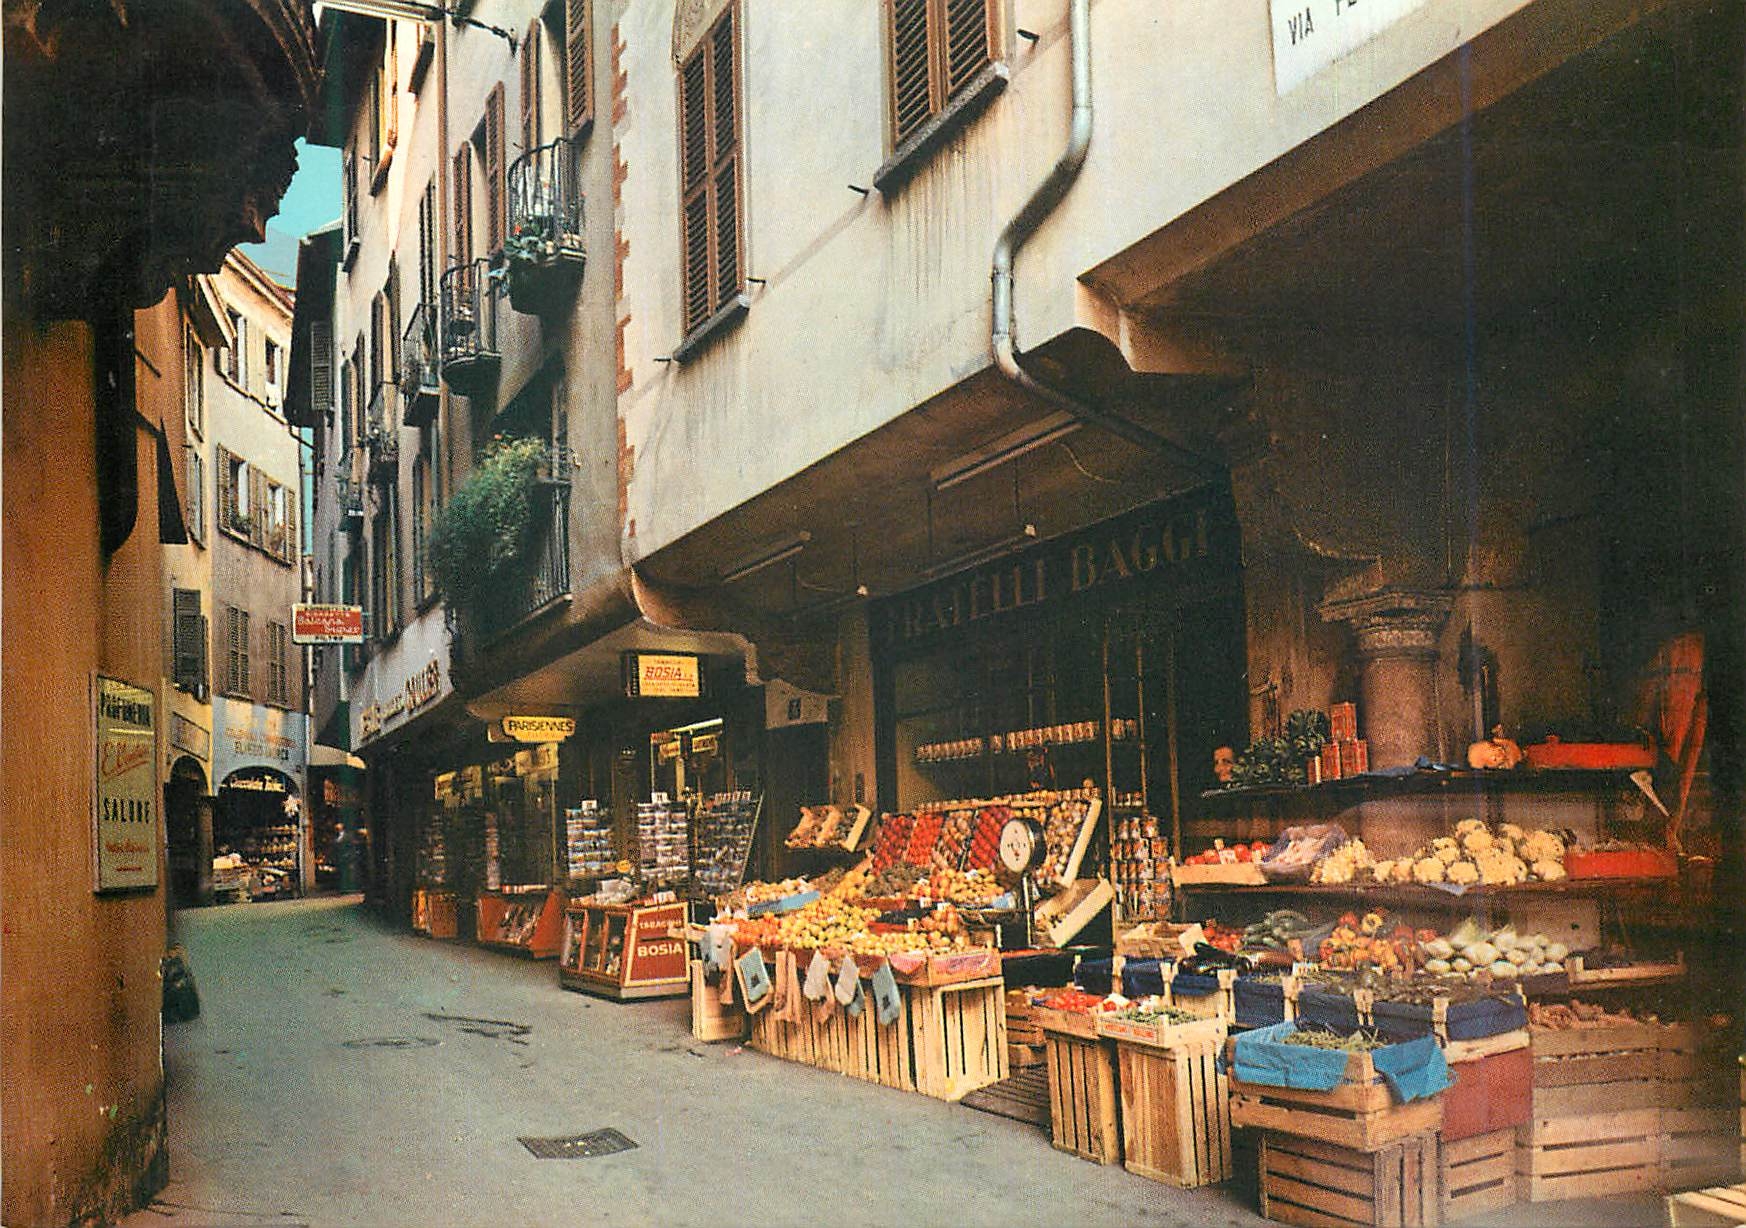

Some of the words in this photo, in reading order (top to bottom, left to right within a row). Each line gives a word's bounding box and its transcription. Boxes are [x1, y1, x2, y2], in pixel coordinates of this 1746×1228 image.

[1288, 7, 1315, 45] VIA
[1069, 508, 1210, 593] BAGGI
[644, 665, 683, 678] BOSIA
[508, 720, 574, 732] PARISIENNES
[636, 942, 684, 957] BOSIA
